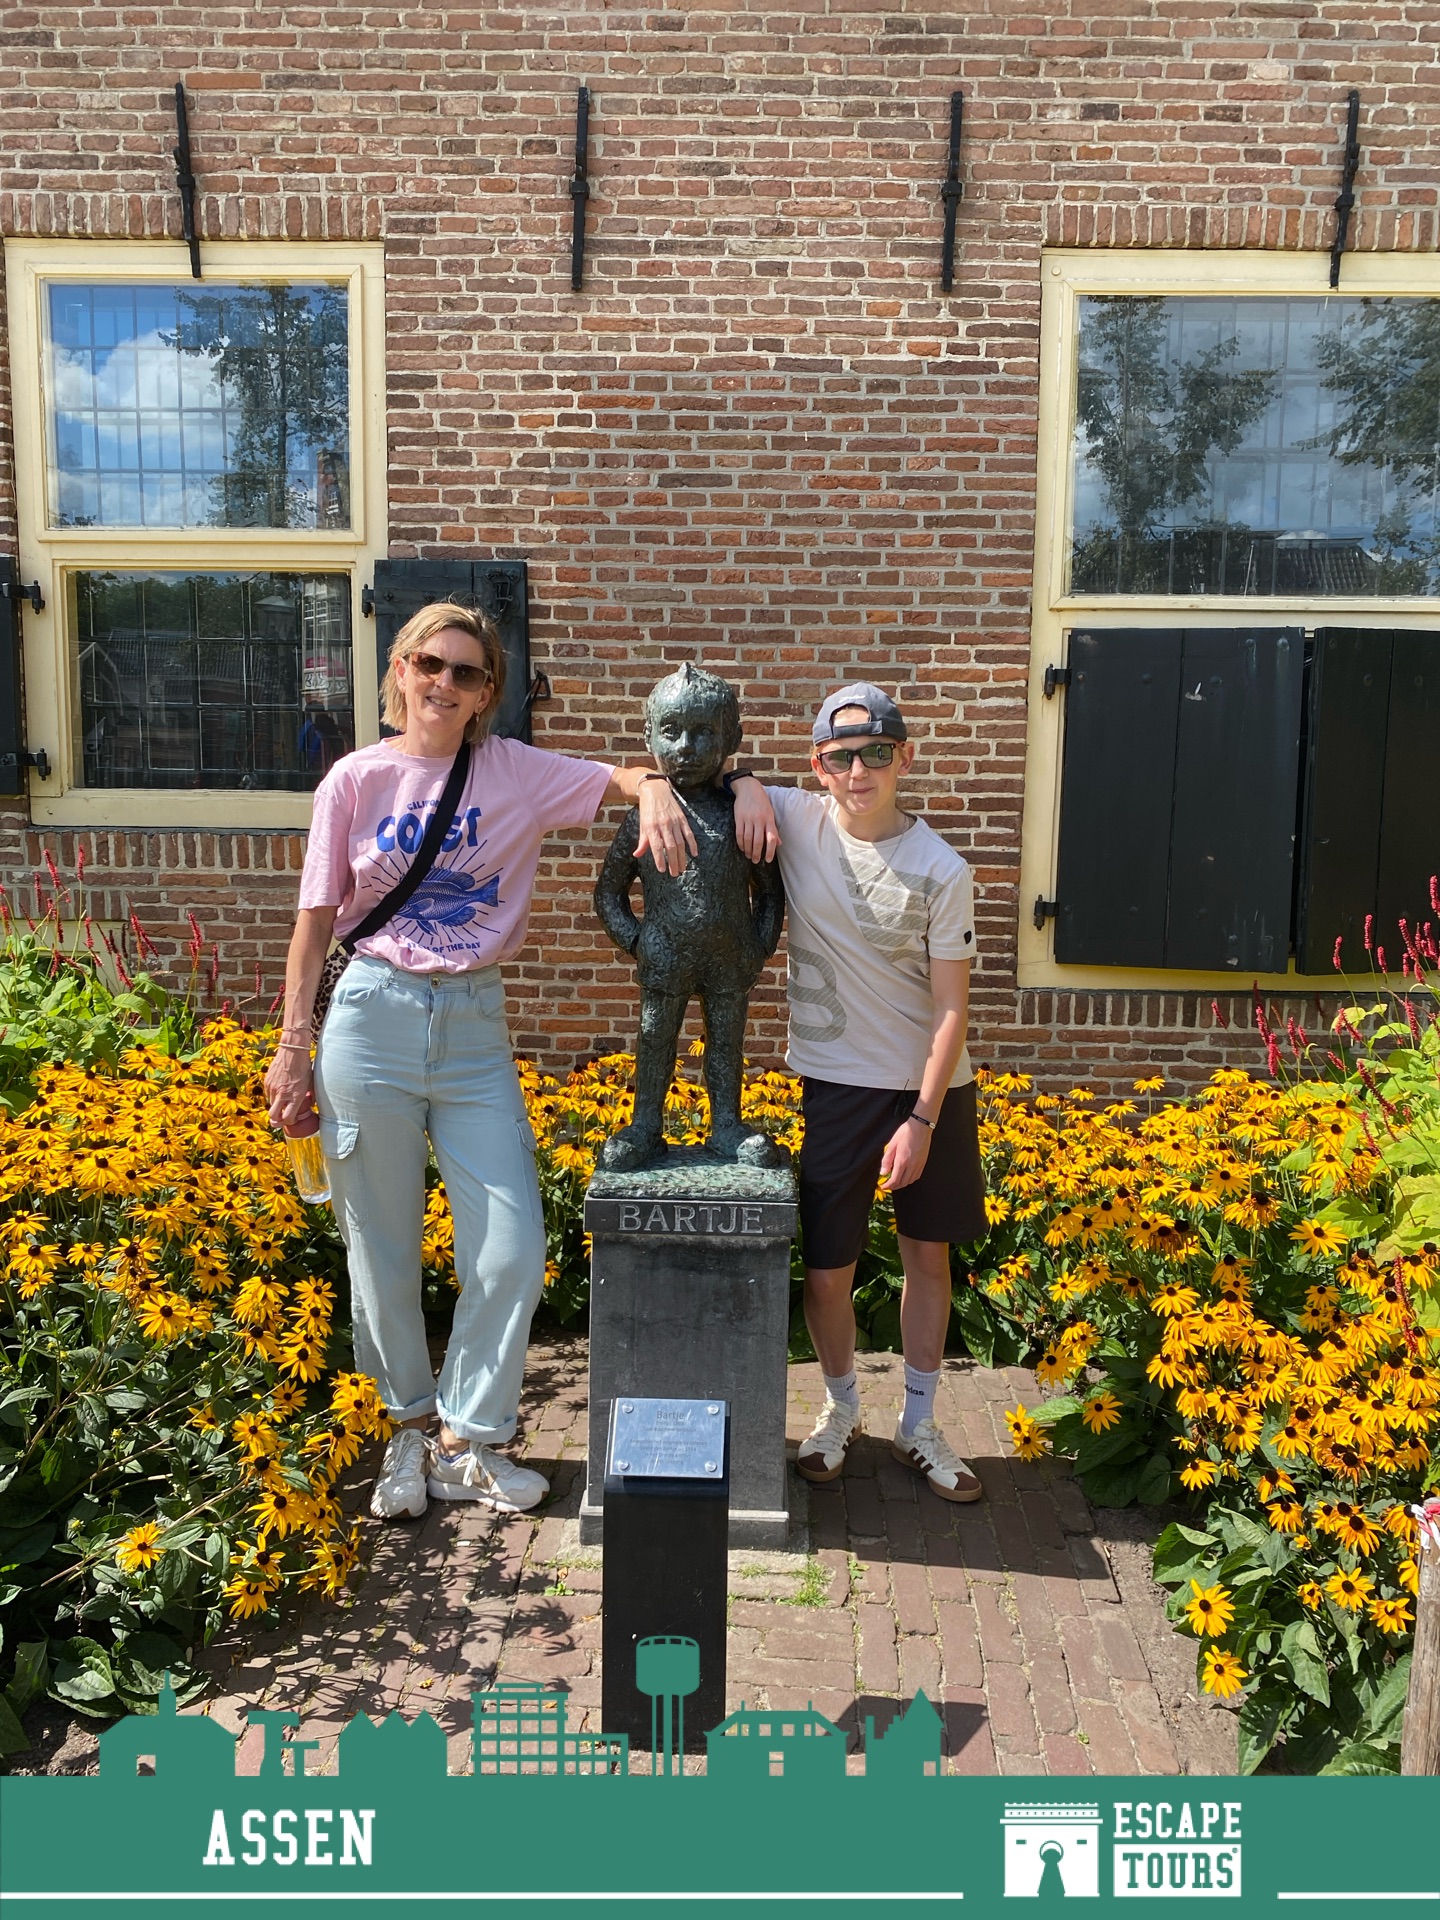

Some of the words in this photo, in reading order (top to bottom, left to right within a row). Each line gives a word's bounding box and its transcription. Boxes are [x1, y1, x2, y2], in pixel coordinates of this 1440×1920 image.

[432, 946, 445, 954] OF
[446, 943, 464, 953] THE
[465, 942, 481, 950] DAY
[618, 1204, 763, 1234] BARTJE
[656, 1410, 685, 1420] Bartje
